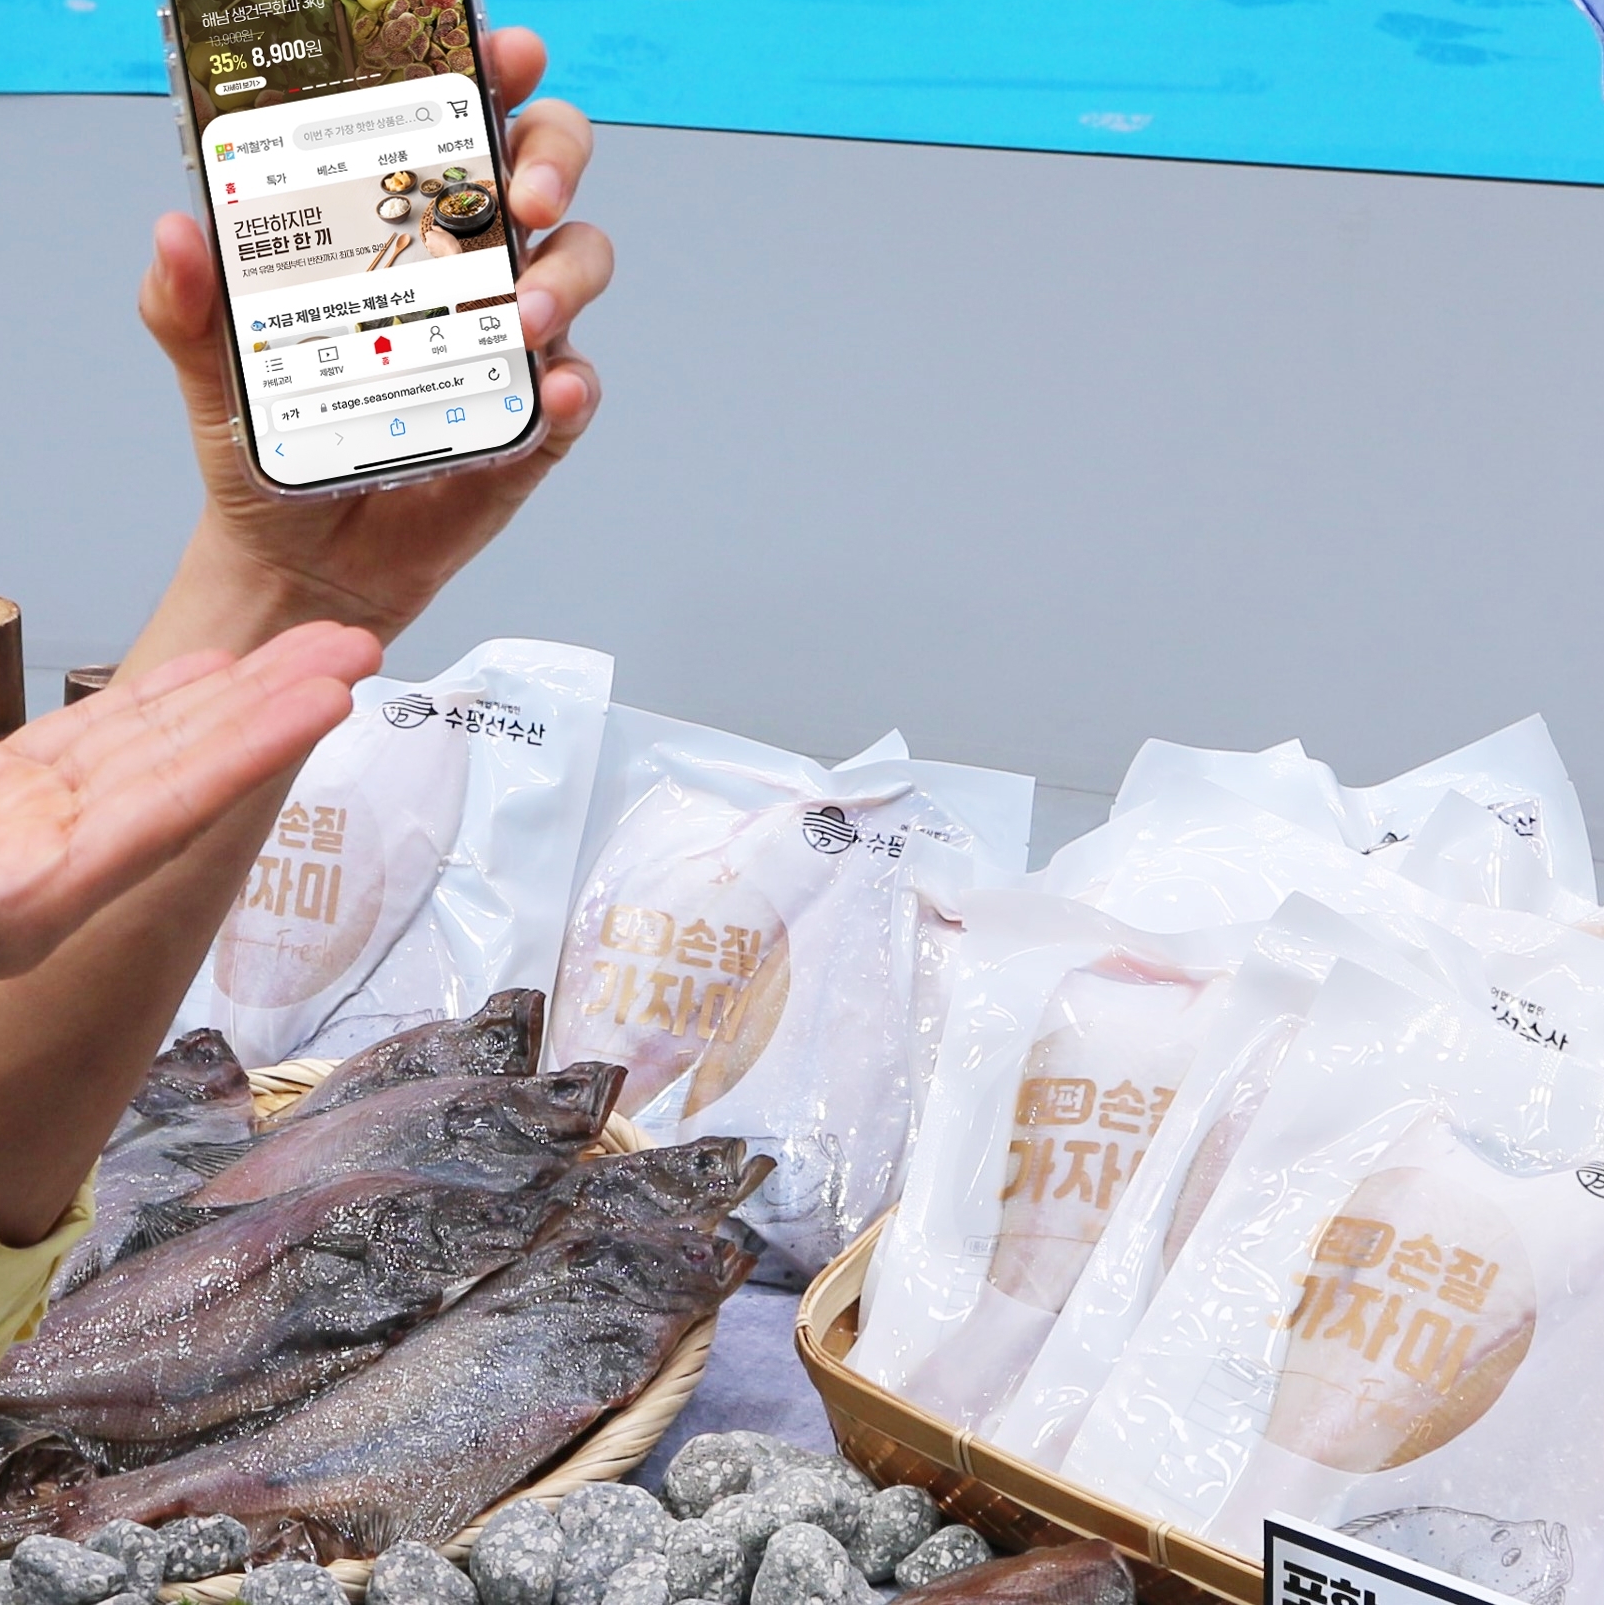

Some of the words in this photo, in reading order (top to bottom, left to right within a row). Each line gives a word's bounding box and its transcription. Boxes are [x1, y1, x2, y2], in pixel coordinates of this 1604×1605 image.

[201, 10, 230, 28] 해남
[209, 52, 248, 75] 35%
[251, 39, 323, 68] 8,900원
[236, 136, 284, 155] 제철장터
[303, 127, 323, 143] 이번
[324, 126, 334, 138] 주
[335, 121, 354, 137] 가장
[356, 118, 375, 133] 핫한
[225, 182, 237, 195] 홈
[266, 173, 287, 187] 특가
[317, 162, 348, 177] 베스트
[378, 150, 408, 166] 신상품
[437, 137, 474, 154] MD추천
[234, 206, 323, 239] 간단하지만
[238, 235, 290, 262] 든든한
[293, 230, 311, 251] 한
[314, 227, 333, 246] 끼
[355, 246, 371, 256] 50%
[268, 313, 294, 329] 지금
[295, 307, 321, 324] 제일
[322, 300, 361, 319] 맛있는
[362, 294, 389, 311] 제철
[390, 288, 416, 306] 수산
[431, 344, 447, 356] 마이
[478, 333, 508, 346] 배송정보
[262, 376, 293, 389] 카테고리
[330, 376, 465, 412] stage.seasonmarket.co.kr
[445, 707, 546, 746] 수평선수산
[278, 801, 347, 855] 손질
[237, 855, 342, 925] 자미
[676, 918, 761, 978] 손질
[581, 960, 752, 1043] 가자미
[998, 1138, 1146, 1210] 가자
[1387, 1233, 1500, 1315] 손질
[1266, 1274, 1477, 1395] 가자미
